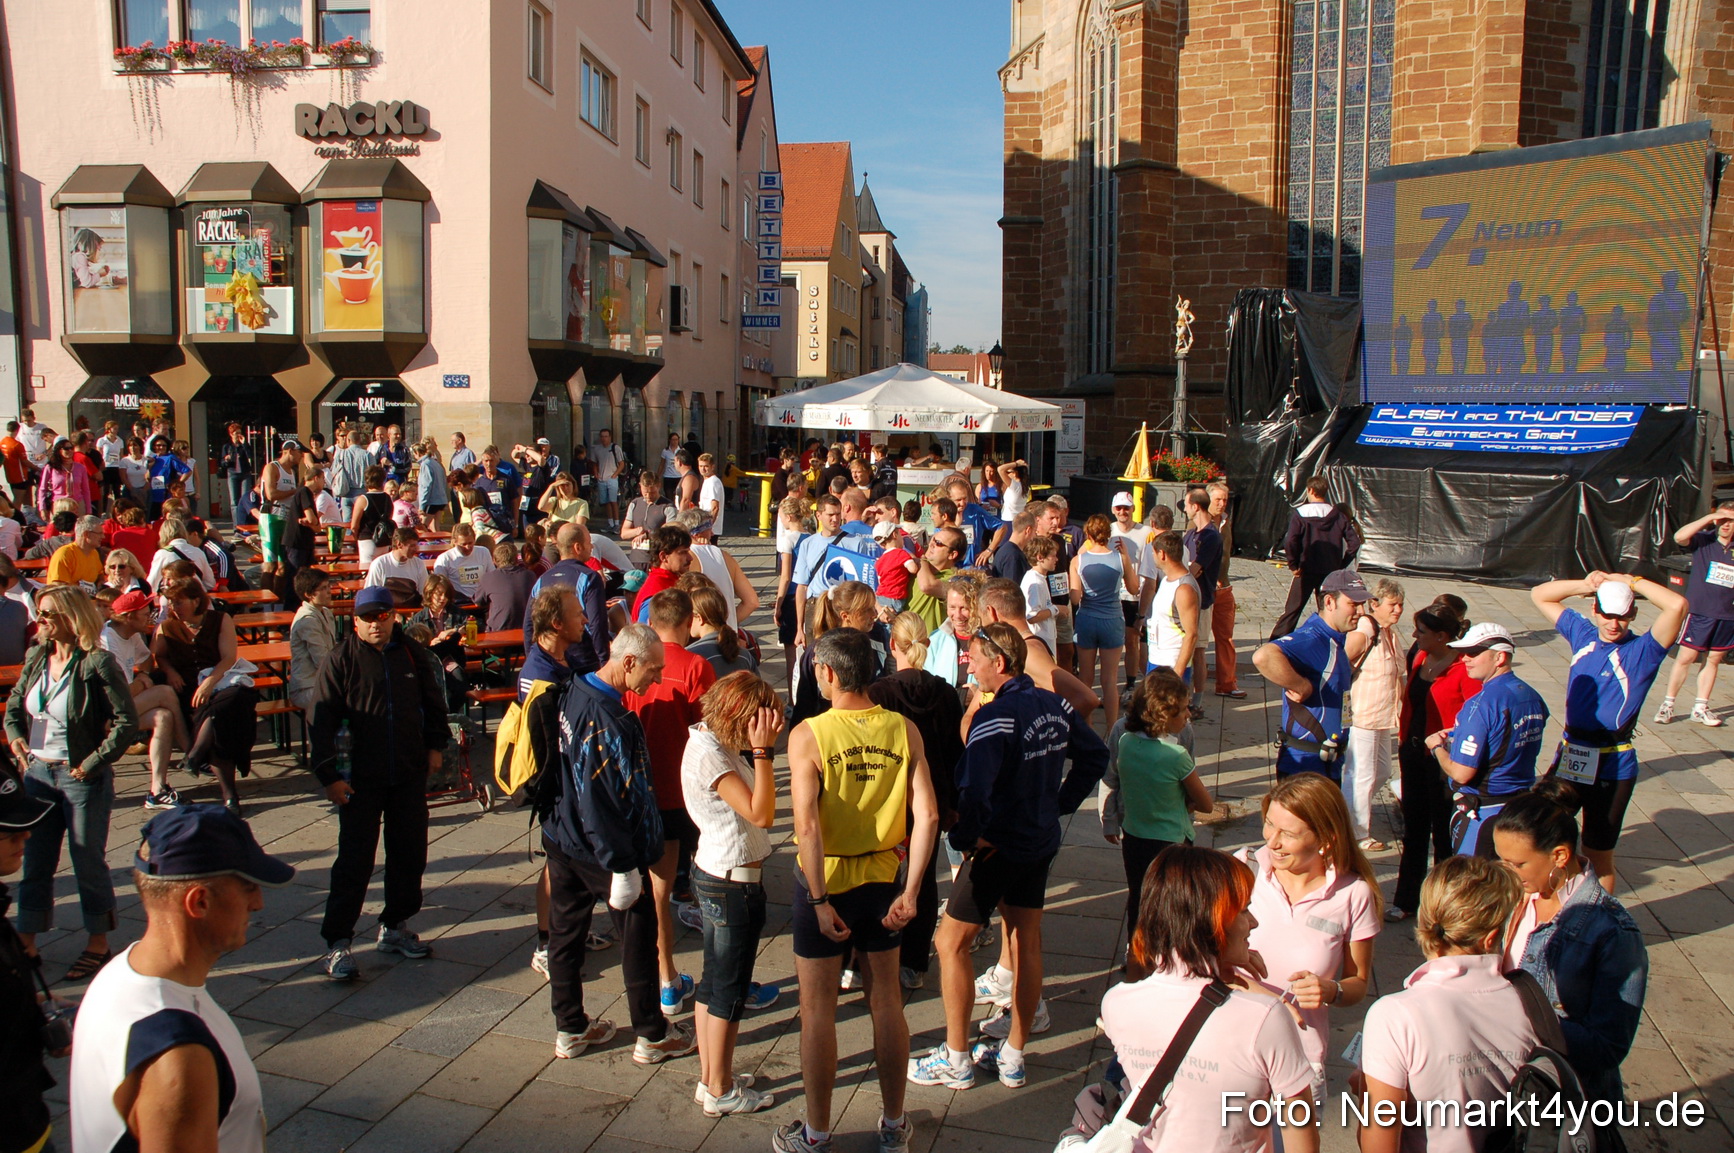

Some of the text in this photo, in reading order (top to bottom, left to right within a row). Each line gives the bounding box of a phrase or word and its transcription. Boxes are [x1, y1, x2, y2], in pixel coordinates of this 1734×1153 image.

[295, 100, 428, 137] RACKL
[198, 220, 240, 241] RACKL
[1473, 219, 1564, 243] Neum
[763, 175, 776, 304] BETTEN
[744, 316, 779, 328] WIMMER
[1412, 381, 1625, 395] www.stadtlauf-neumarkt.de
[113, 393, 140, 408] RACKL
[358, 397, 386, 411] RACKL
[1376, 408, 1459, 421] FLASH
[1505, 409, 1635, 423] THUNDER
[465, 572, 479, 580] 703
[826, 745, 904, 768] TSV 1883 Allersberg
[1568, 746, 1591, 758] Michael
[845, 761, 887, 772] Marathon-
[854, 772, 876, 783] Team
